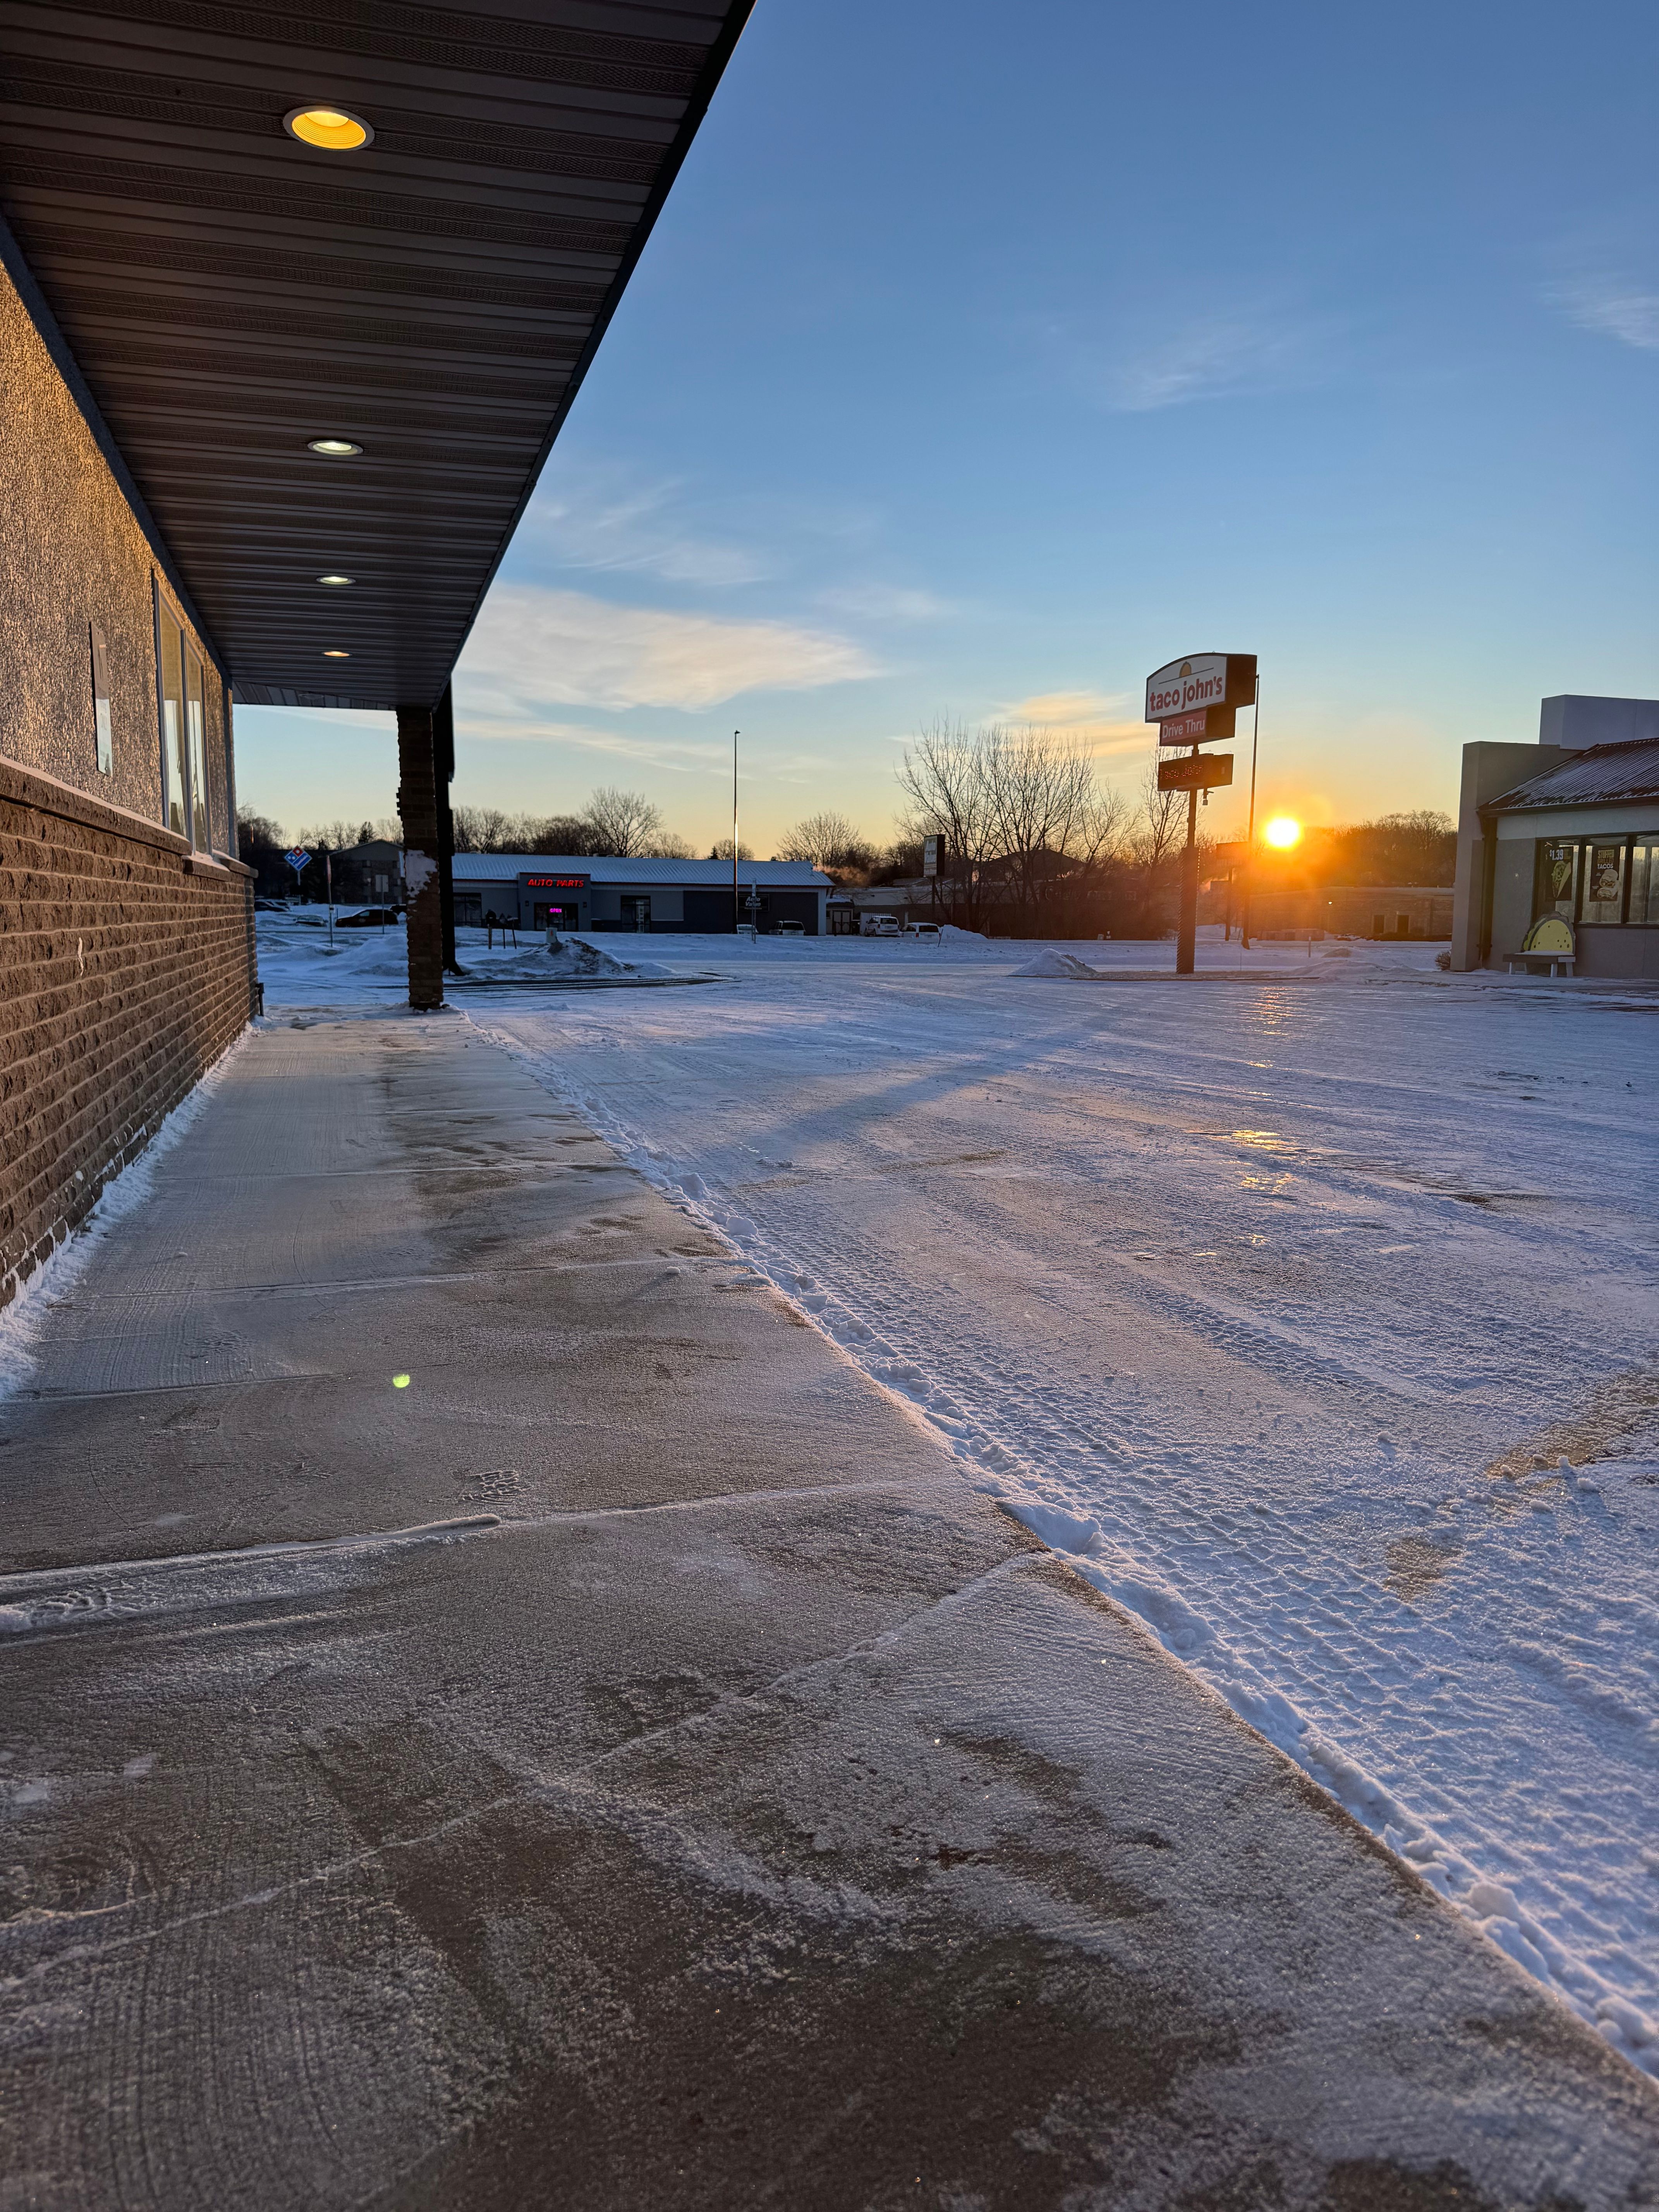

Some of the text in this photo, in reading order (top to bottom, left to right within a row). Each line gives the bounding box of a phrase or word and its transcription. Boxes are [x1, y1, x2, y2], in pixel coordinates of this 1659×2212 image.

[1150, 676, 1222, 711] taco john's
[1163, 719, 1205, 738] Drive Thru
[1549, 849, 1563, 860] $1.39
[1598, 849, 1614, 859] STUFFED
